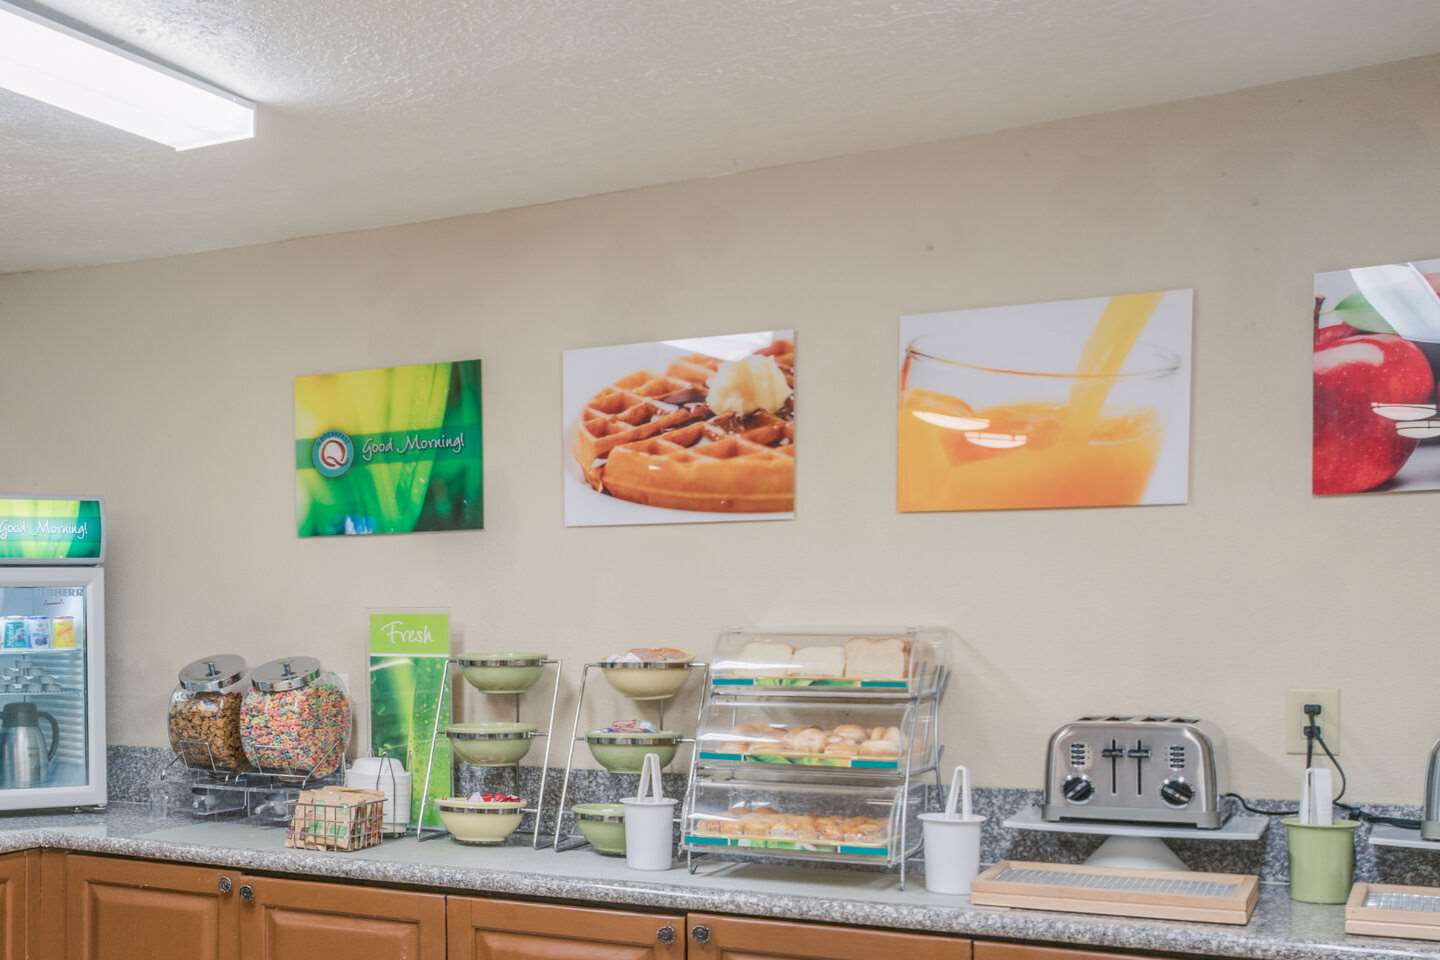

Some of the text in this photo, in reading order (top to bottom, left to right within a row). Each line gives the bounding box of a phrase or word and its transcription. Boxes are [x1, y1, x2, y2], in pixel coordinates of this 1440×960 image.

[362, 436, 394, 461] Good
[396, 432, 465, 454] Morning!
[31, 519, 88, 540] Morning!
[380, 620, 434, 644] Fresh
